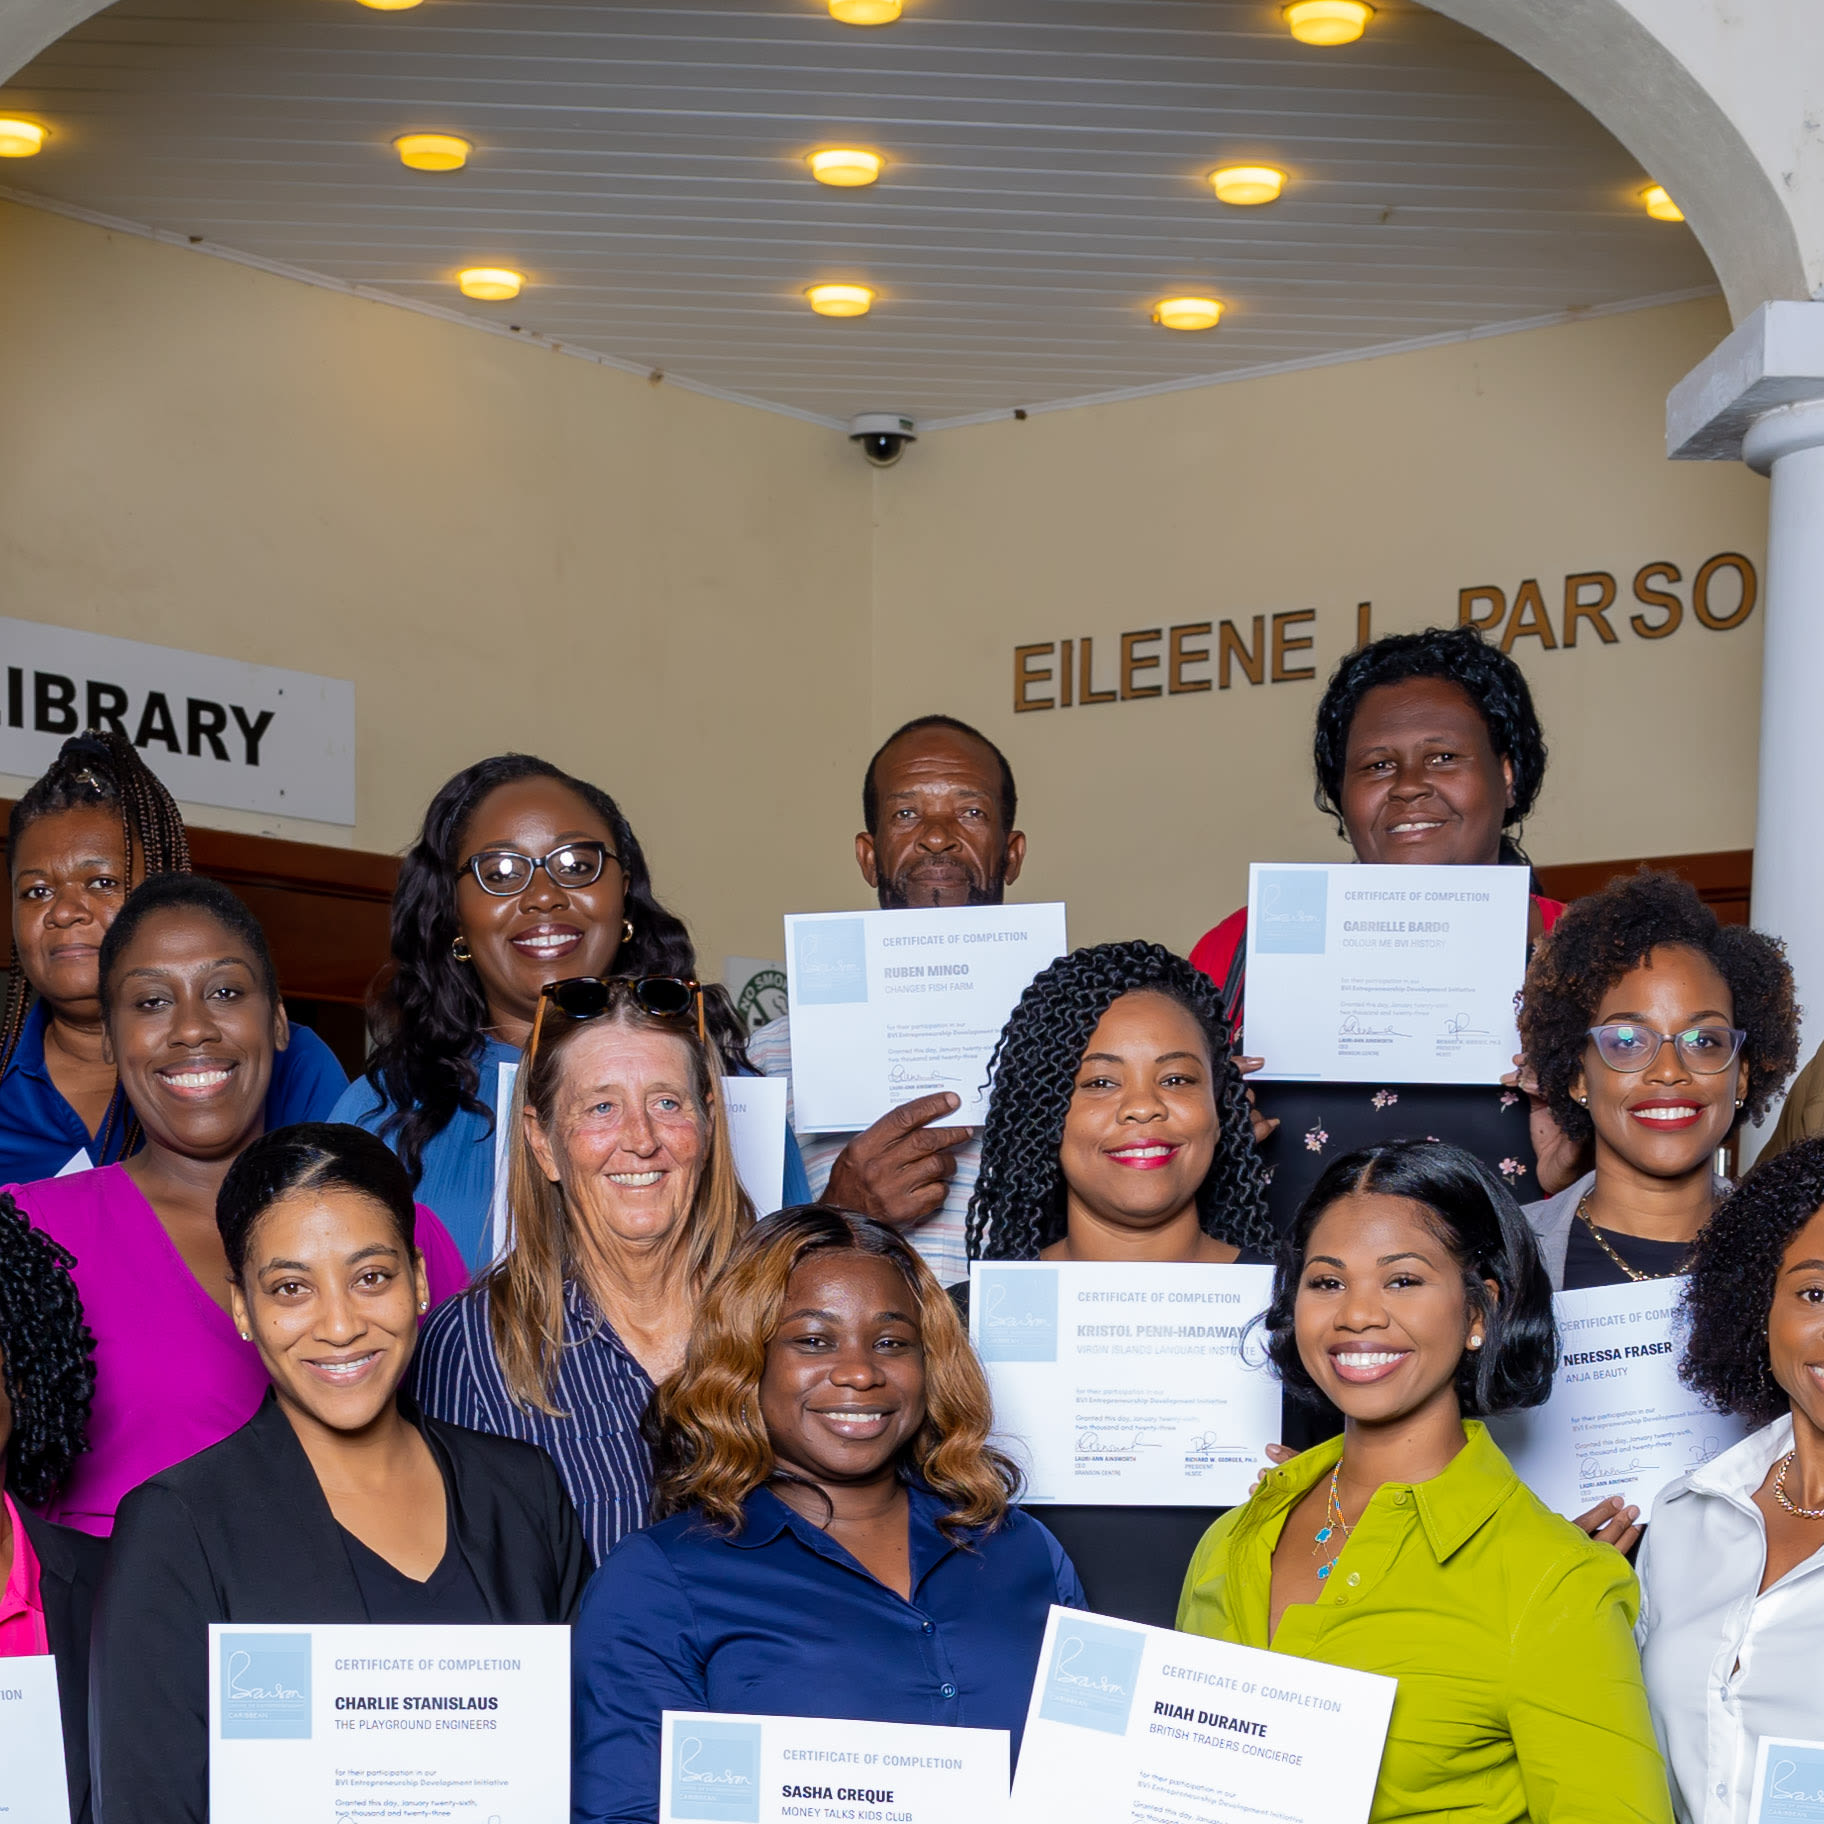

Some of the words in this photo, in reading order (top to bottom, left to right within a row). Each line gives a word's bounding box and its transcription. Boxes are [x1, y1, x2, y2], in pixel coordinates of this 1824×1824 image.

[1013, 608, 1317, 714] EILEENE
[1458, 552, 1757, 655] PARSO
[1345, 892, 1406, 901] CERTIFICATE
[1410, 892, 1422, 901] OF
[1425, 892, 1489, 902] COMPLETION
[1344, 921, 1405, 932] GABRIELLE
[1408, 922, 1449, 933] BARDO
[883, 935, 944, 947] CERTIFICATE
[948, 935, 960, 944] OF
[963, 932, 1028, 943] COMPLETION
[1343, 939, 1376, 947] COLOUR
[1379, 939, 1392, 947] ME
[1394, 939, 1408, 948] BVI
[1410, 939, 1446, 948] HISTORY
[884, 966, 924, 978] RUBEN
[928, 964, 969, 976] MINGO
[754, 972, 787, 991] SMO
[885, 984, 926, 994] CHANGES
[929, 983, 947, 992] FISH
[950, 982, 974, 991] FARM
[1078, 1292, 1146, 1303] CERTIFICATE
[1151, 1293, 1165, 1303] OF
[1168, 1293, 1240, 1304] COMPLETION
[1560, 1315, 1625, 1332] CERTIFICATE
[1629, 1313, 1642, 1324] OF
[1137, 1326, 1245, 1338] PENN-HADAWAY
[1564, 1348, 1621, 1366] NERESSA
[1626, 1342, 1672, 1359] FRASER
[1566, 1372, 1590, 1383] ANJA
[1593, 1367, 1628, 1380] BEAUTY
[335, 1659, 414, 1671] CERTIFICATE
[418, 1659, 434, 1671] OF
[438, 1659, 521, 1671] COMPLETION
[1162, 1664, 1238, 1692] CERTIFICATE
[1242, 1681, 1257, 1696] OF
[1261, 1685, 1342, 1714] COMPLETION
[335, 1697, 399, 1710] CHARLIE
[403, 1697, 498, 1710] STANISLAUS
[335, 1720, 356, 1730] THE
[359, 1720, 431, 1730] PLAYGROUND
[435, 1720, 497, 1730] ENGINEERS
[1154, 1701, 1194, 1723] RIIAH
[1197, 1709, 1268, 1738] DURANTE
[1150, 1723, 1190, 1742] BRITISH
[1193, 1732, 1239, 1753] TRADERS
[1242, 1742, 1303, 1767] CONCIERGE
[783, 1749, 859, 1764] CERTIFICATE
[864, 1753, 878, 1765] OF
[883, 1754, 962, 1770] COMPLETION
[783, 1785, 833, 1800] SASHA
[837, 1787, 894, 1803] CREQUE
[782, 1807, 821, 1818] MONEY
[824, 1808, 855, 1820] TALKS
[858, 1810, 882, 1821] KIDS
[886, 1811, 913, 1822] CLUB
